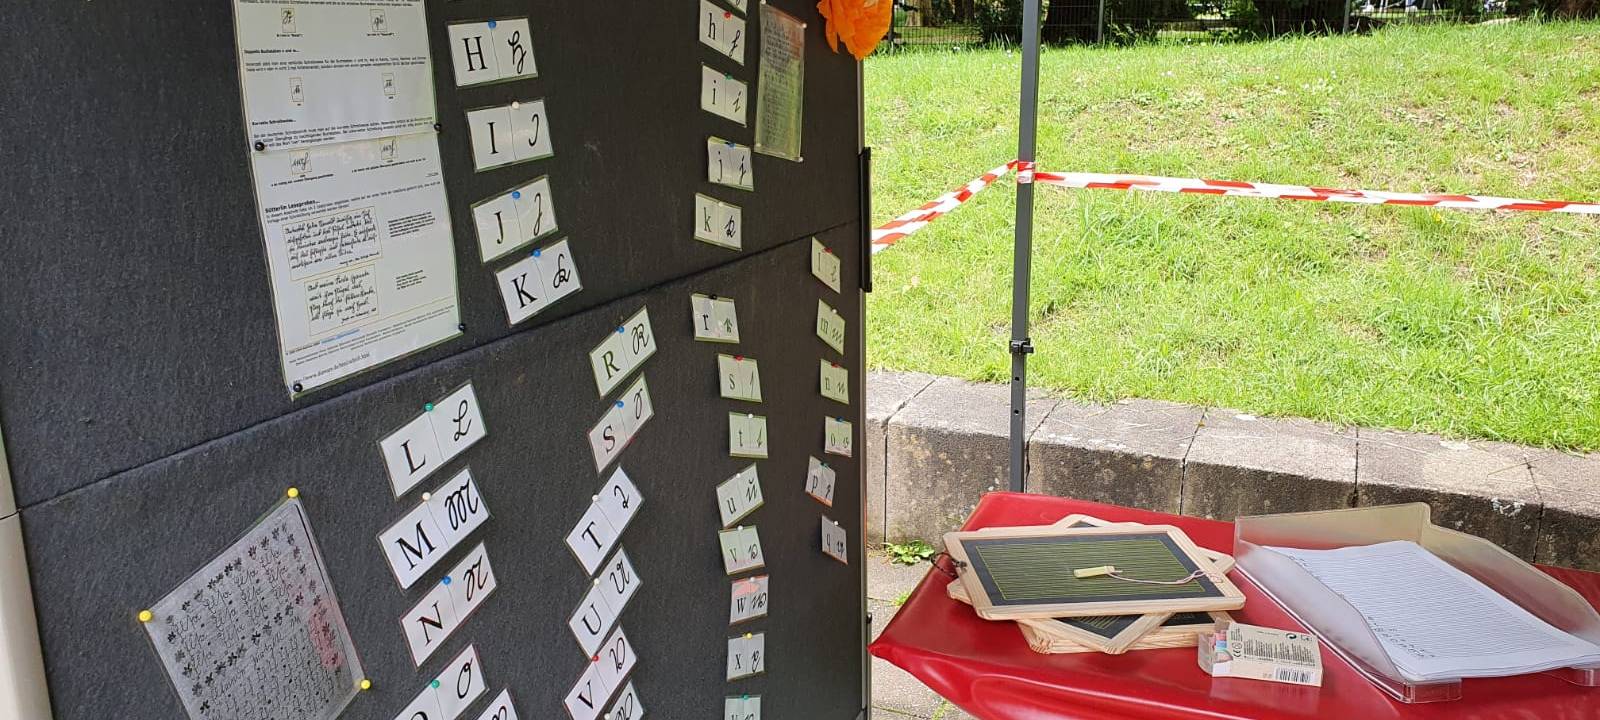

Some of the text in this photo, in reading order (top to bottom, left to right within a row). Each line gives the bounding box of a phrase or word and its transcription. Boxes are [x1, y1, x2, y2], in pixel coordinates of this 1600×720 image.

[708, 13, 716, 40] h
[462, 36, 488, 71] H
[712, 80, 716, 104] i
[487, 122, 499, 154] I
[494, 211, 504, 245] J
[704, 207, 712, 232] k
[512, 273, 538, 309] K
[702, 314, 709, 331] r
[601, 350, 620, 380] R
[603, 425, 616, 454] S
[400, 439, 426, 476] L
[395, 520, 436, 571] M
[581, 521, 603, 552] T
[416, 600, 443, 646] N
[582, 602, 602, 636] U
[577, 680, 594, 710] V
